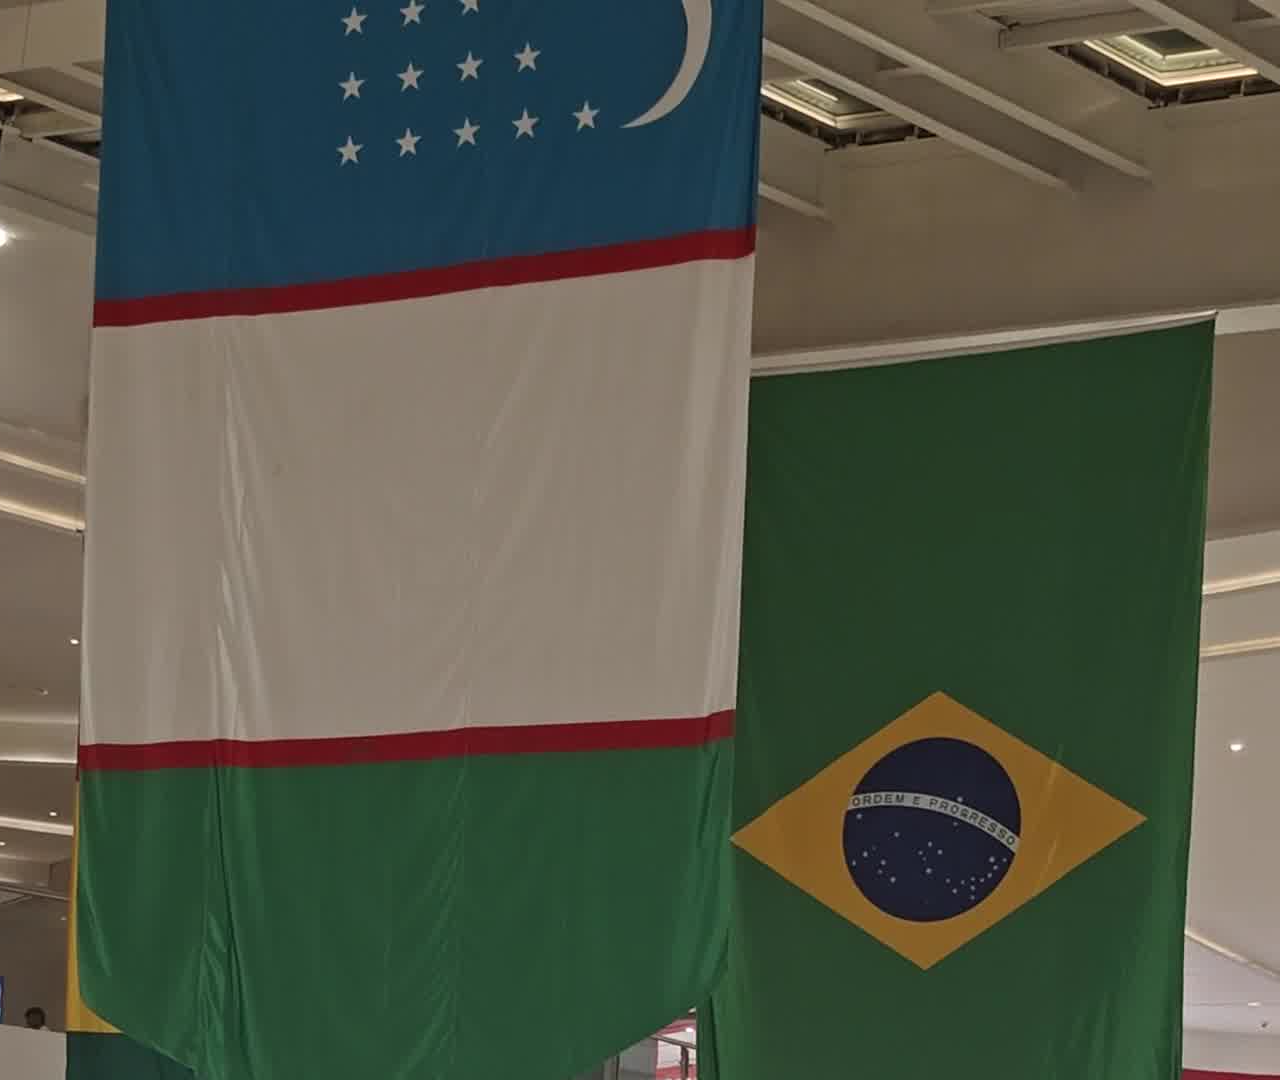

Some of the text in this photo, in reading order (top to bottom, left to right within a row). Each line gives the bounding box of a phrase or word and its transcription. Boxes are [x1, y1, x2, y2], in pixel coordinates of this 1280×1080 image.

[851, 794, 1017, 847] ORDEM E PROGRESSO
